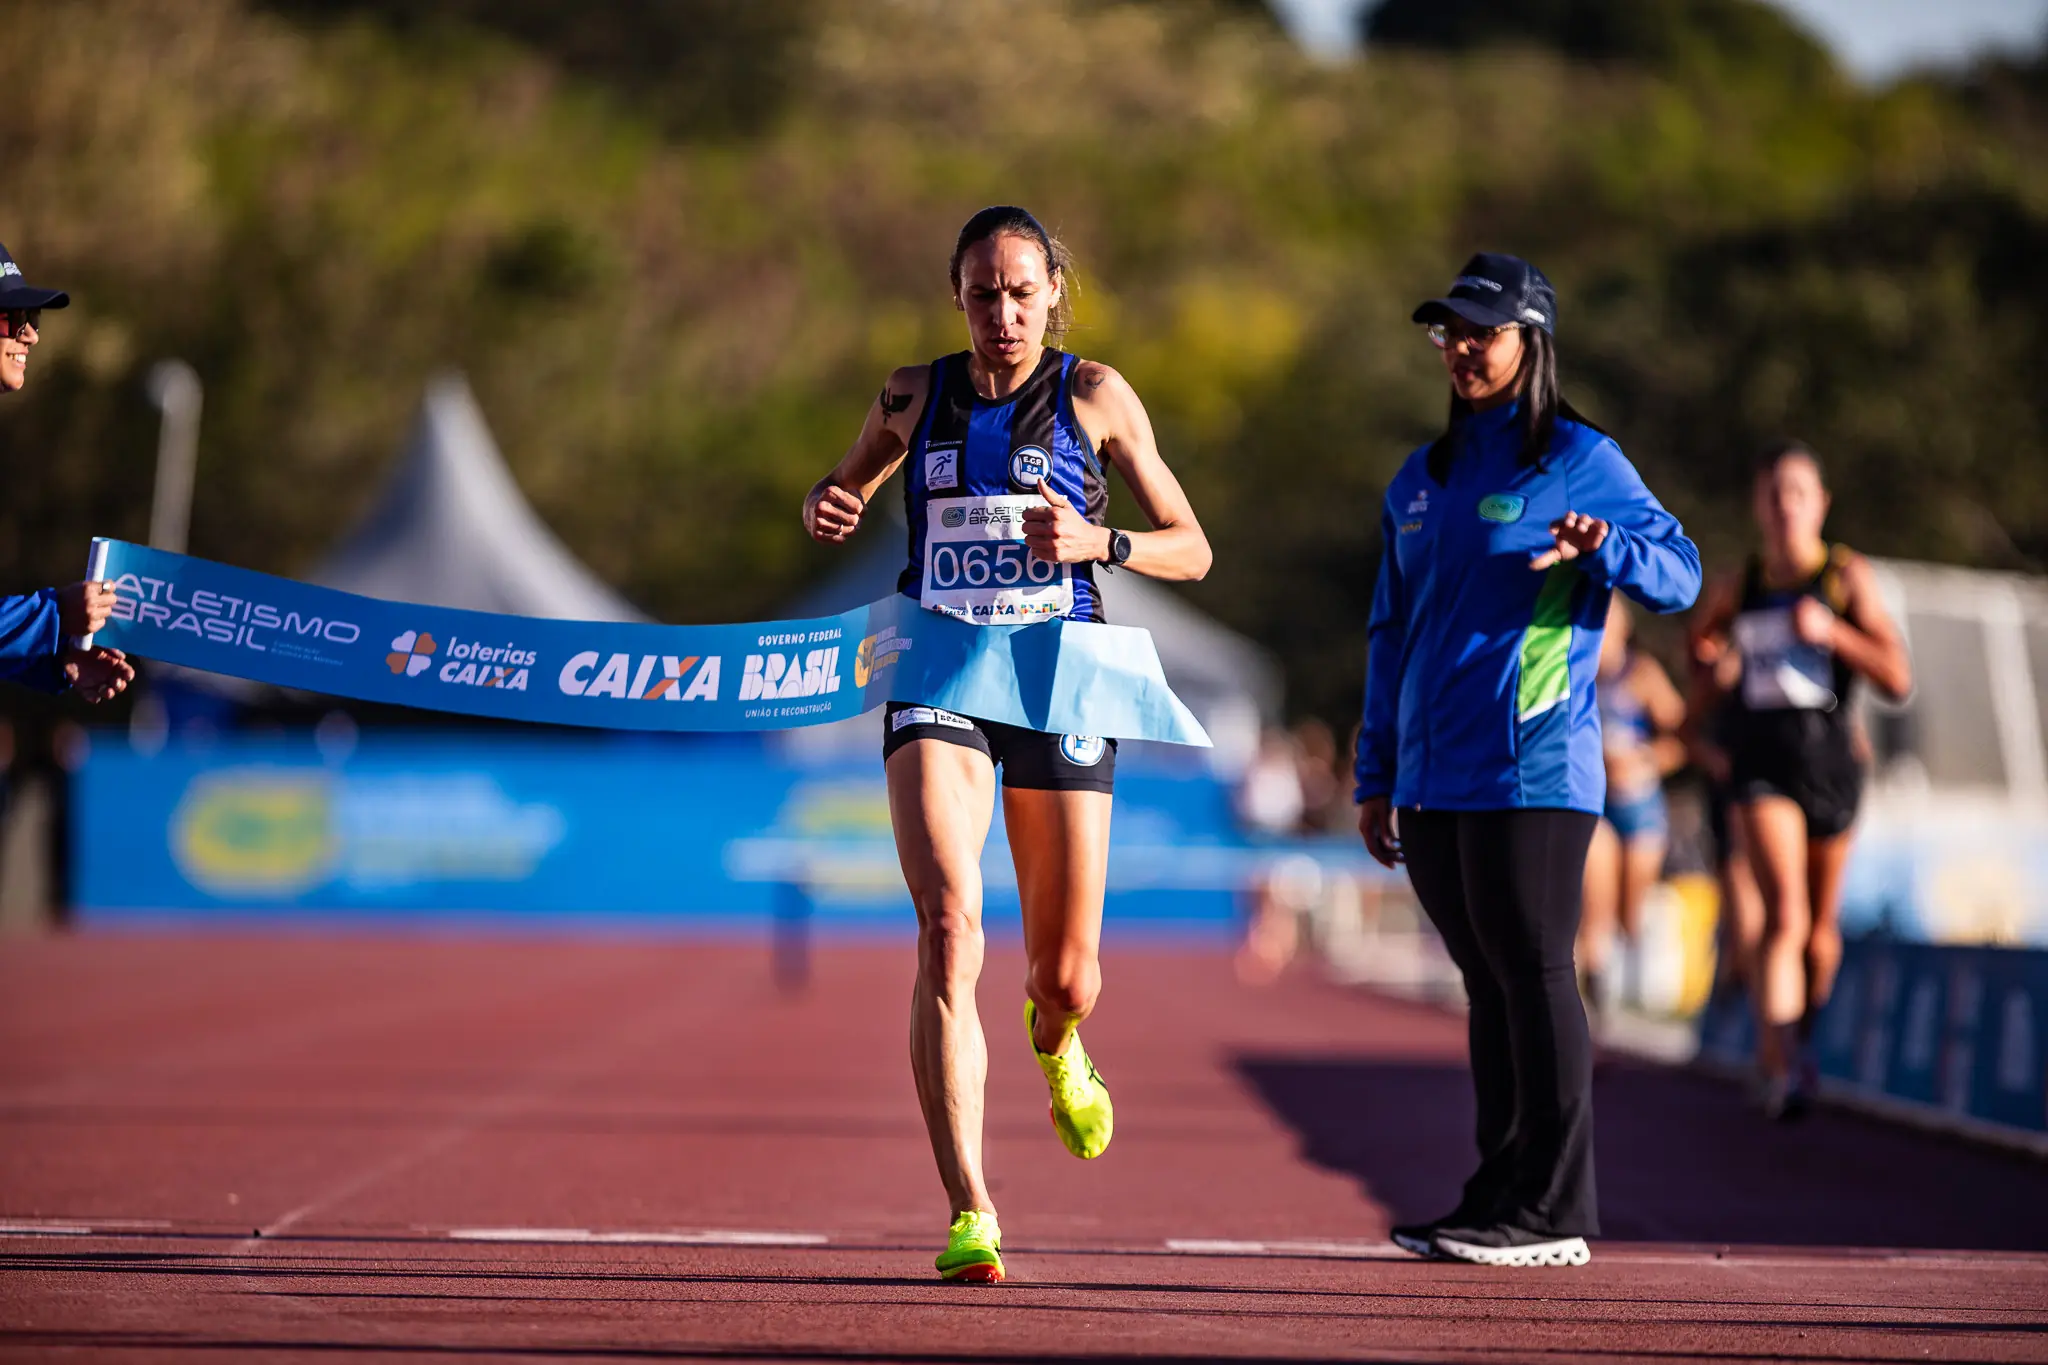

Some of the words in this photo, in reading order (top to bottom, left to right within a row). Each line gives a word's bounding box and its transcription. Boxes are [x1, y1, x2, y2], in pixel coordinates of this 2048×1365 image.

[969, 506, 1049, 517] ATLETIS
[969, 515, 1023, 525] BRASIL
[933, 545, 1055, 587] 0656
[111, 596, 266, 651] BRASIL
[114, 573, 361, 644] ATLETISMO
[972, 604, 1015, 616] CAIXA
[446, 636, 537, 666] loterias
[758, 633, 806, 647] GOVERNO
[808, 628, 842, 643] FEDERAL
[439, 661, 529, 692] CAIXA
[558, 651, 722, 701] CAIXA
[738, 646, 841, 701] BRASIL
[745, 706, 771, 718] UNIÃO
[774, 708, 779, 717] E
[781, 701, 832, 717] RECONSTRUÇÃO
